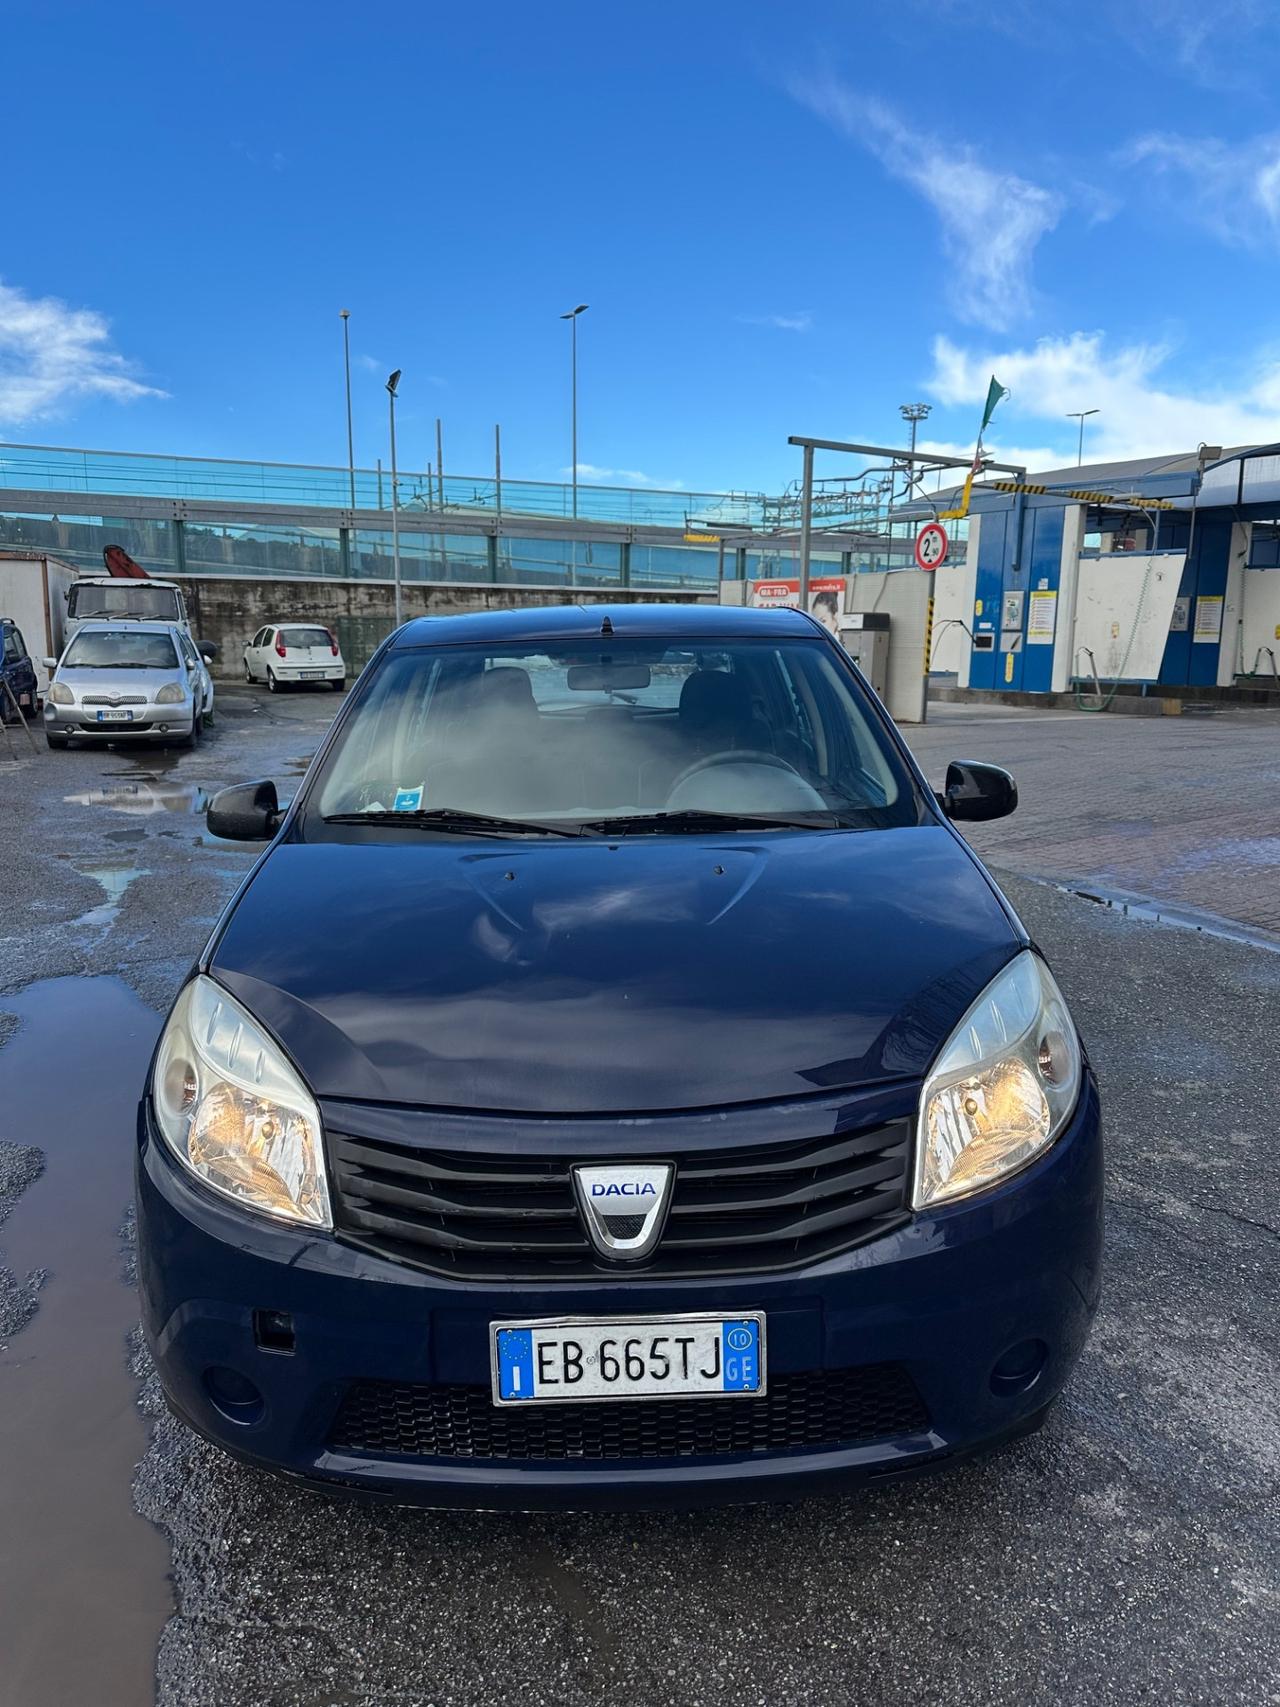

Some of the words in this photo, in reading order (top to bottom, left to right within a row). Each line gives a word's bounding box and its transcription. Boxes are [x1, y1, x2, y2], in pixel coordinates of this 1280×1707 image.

[923, 538, 931, 557] 2
[592, 1183, 656, 1196] DACIA
[733, 1333, 747, 1346] 10
[537, 1341, 584, 1384] EB
[599, 1337, 721, 1382] 665TJ
[726, 1356, 752, 1382] GE
